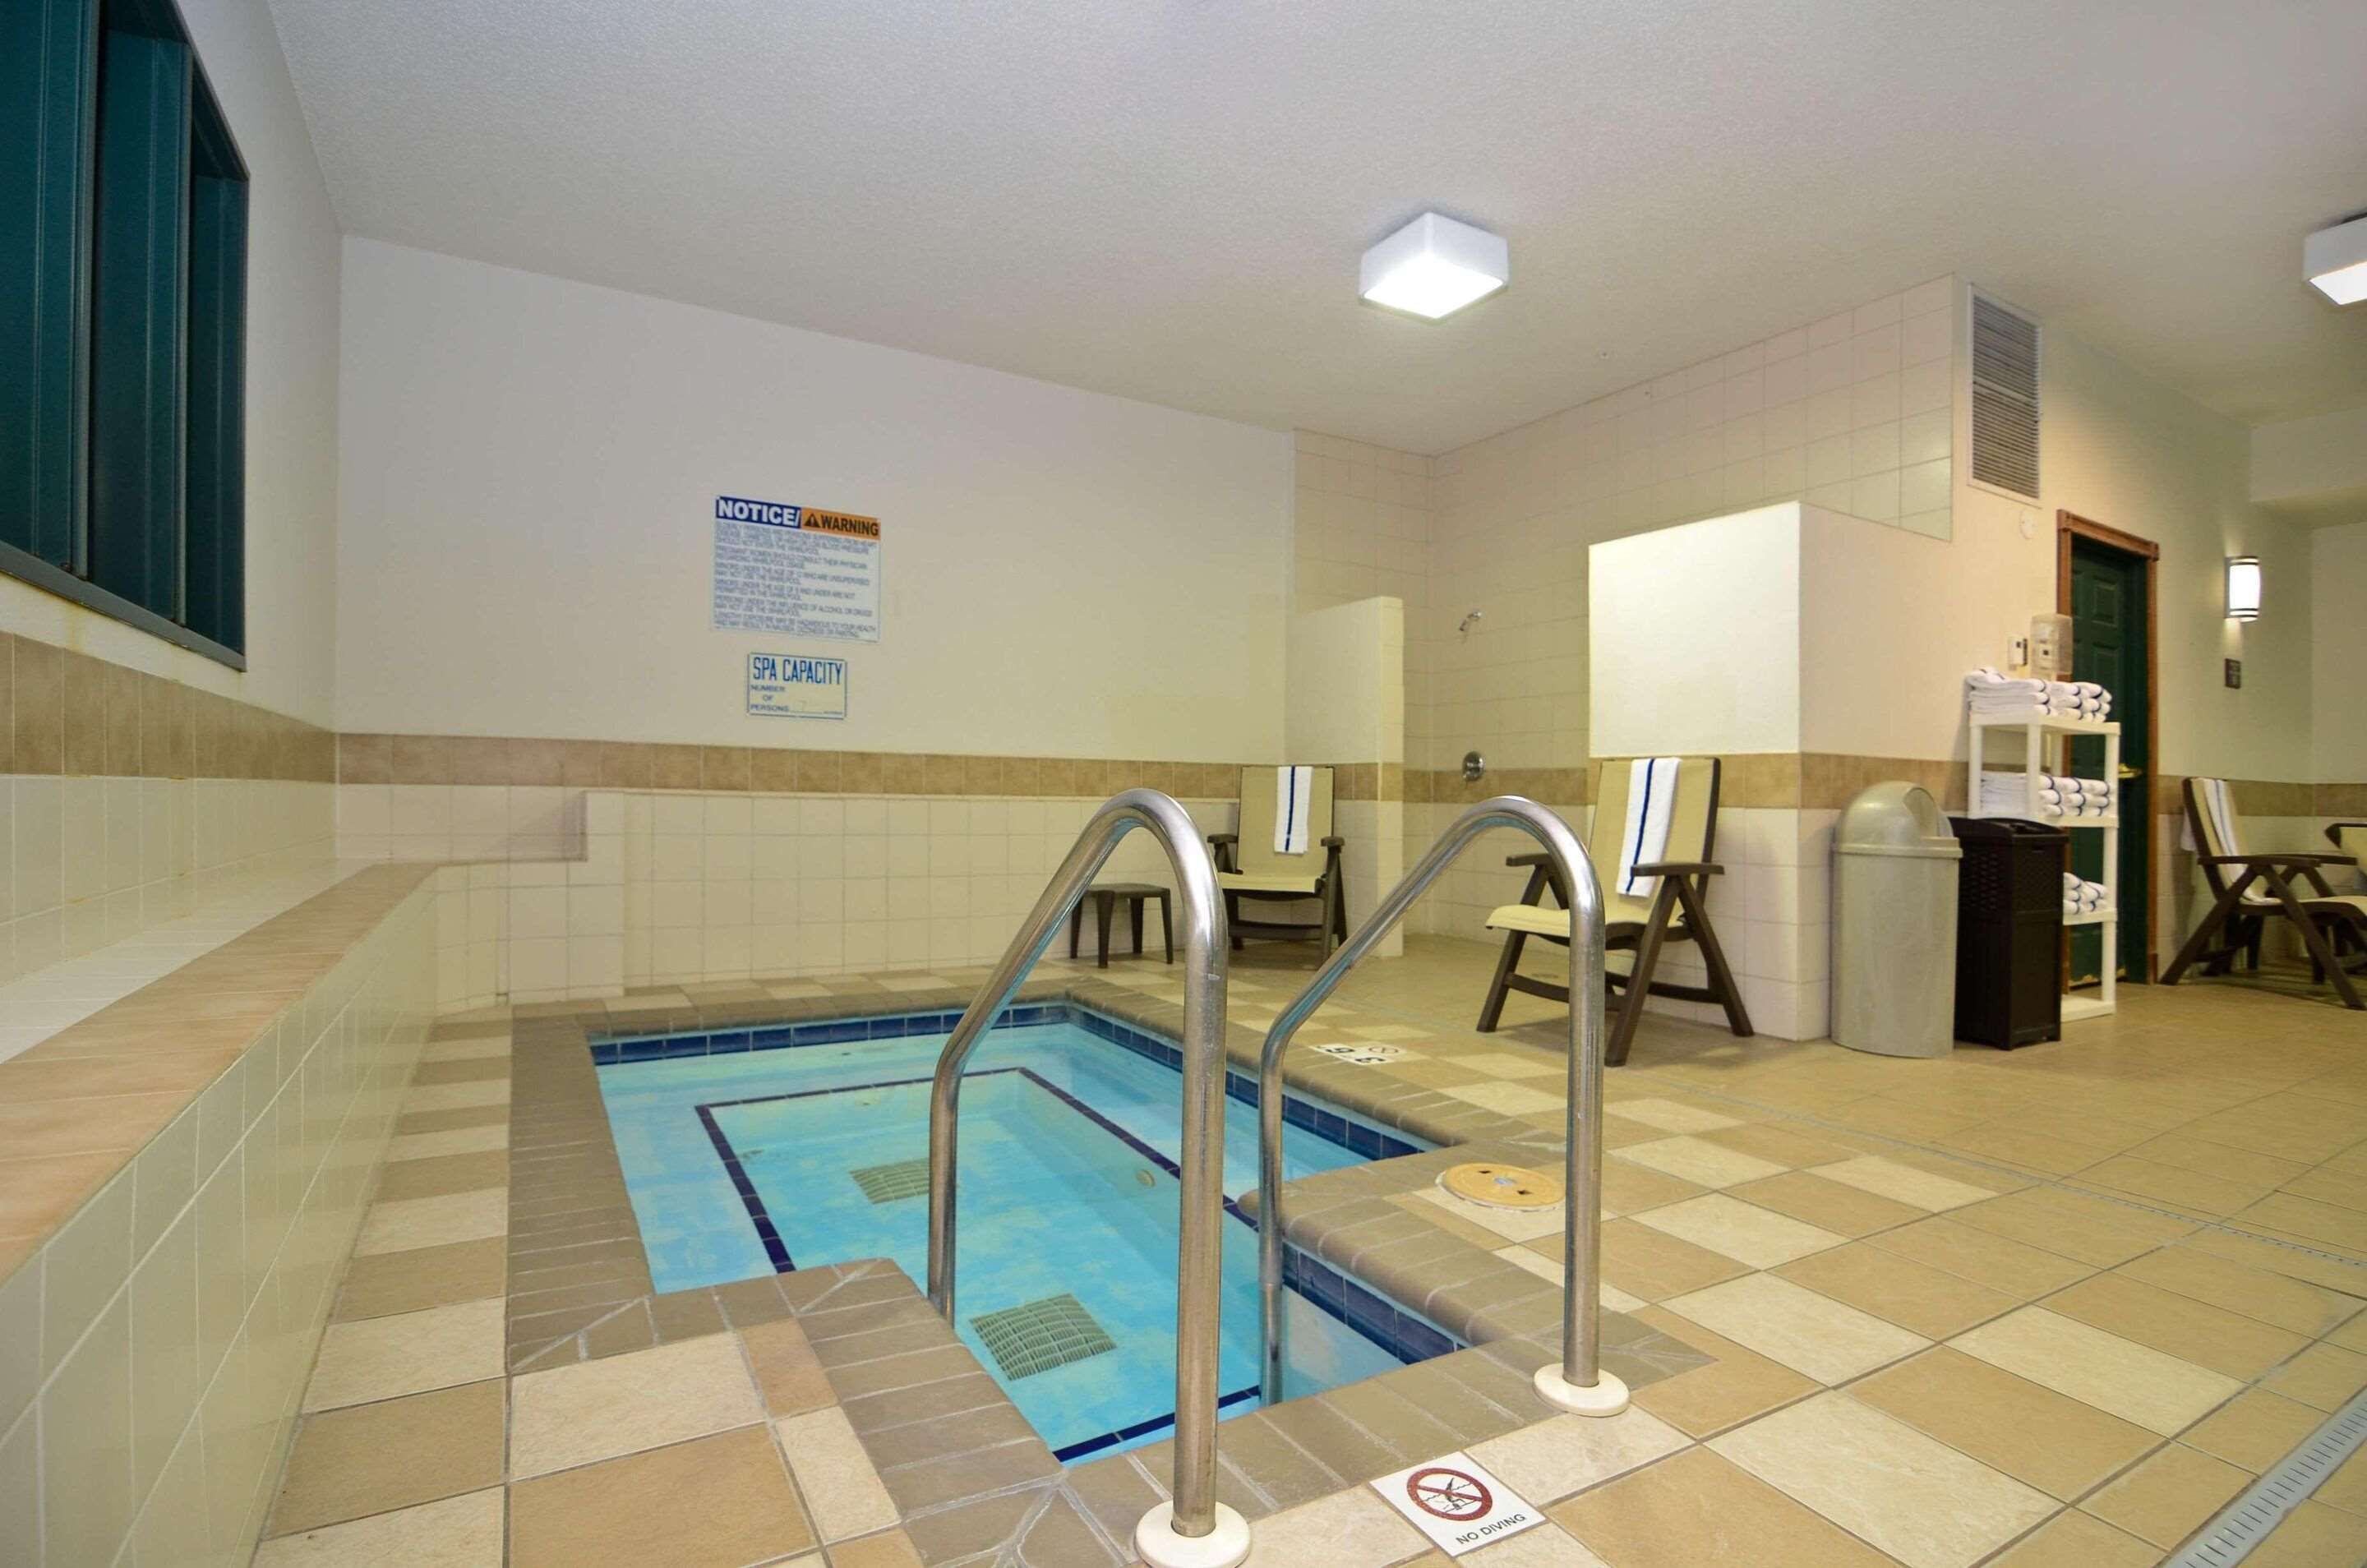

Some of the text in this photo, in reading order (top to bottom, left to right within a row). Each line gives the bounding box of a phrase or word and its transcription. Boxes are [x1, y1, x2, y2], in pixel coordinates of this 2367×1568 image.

[820, 514, 879, 537] WARNING
[753, 657, 842, 685] SPA CAPACITY
[1456, 1514, 1526, 1544] NO DIVING
